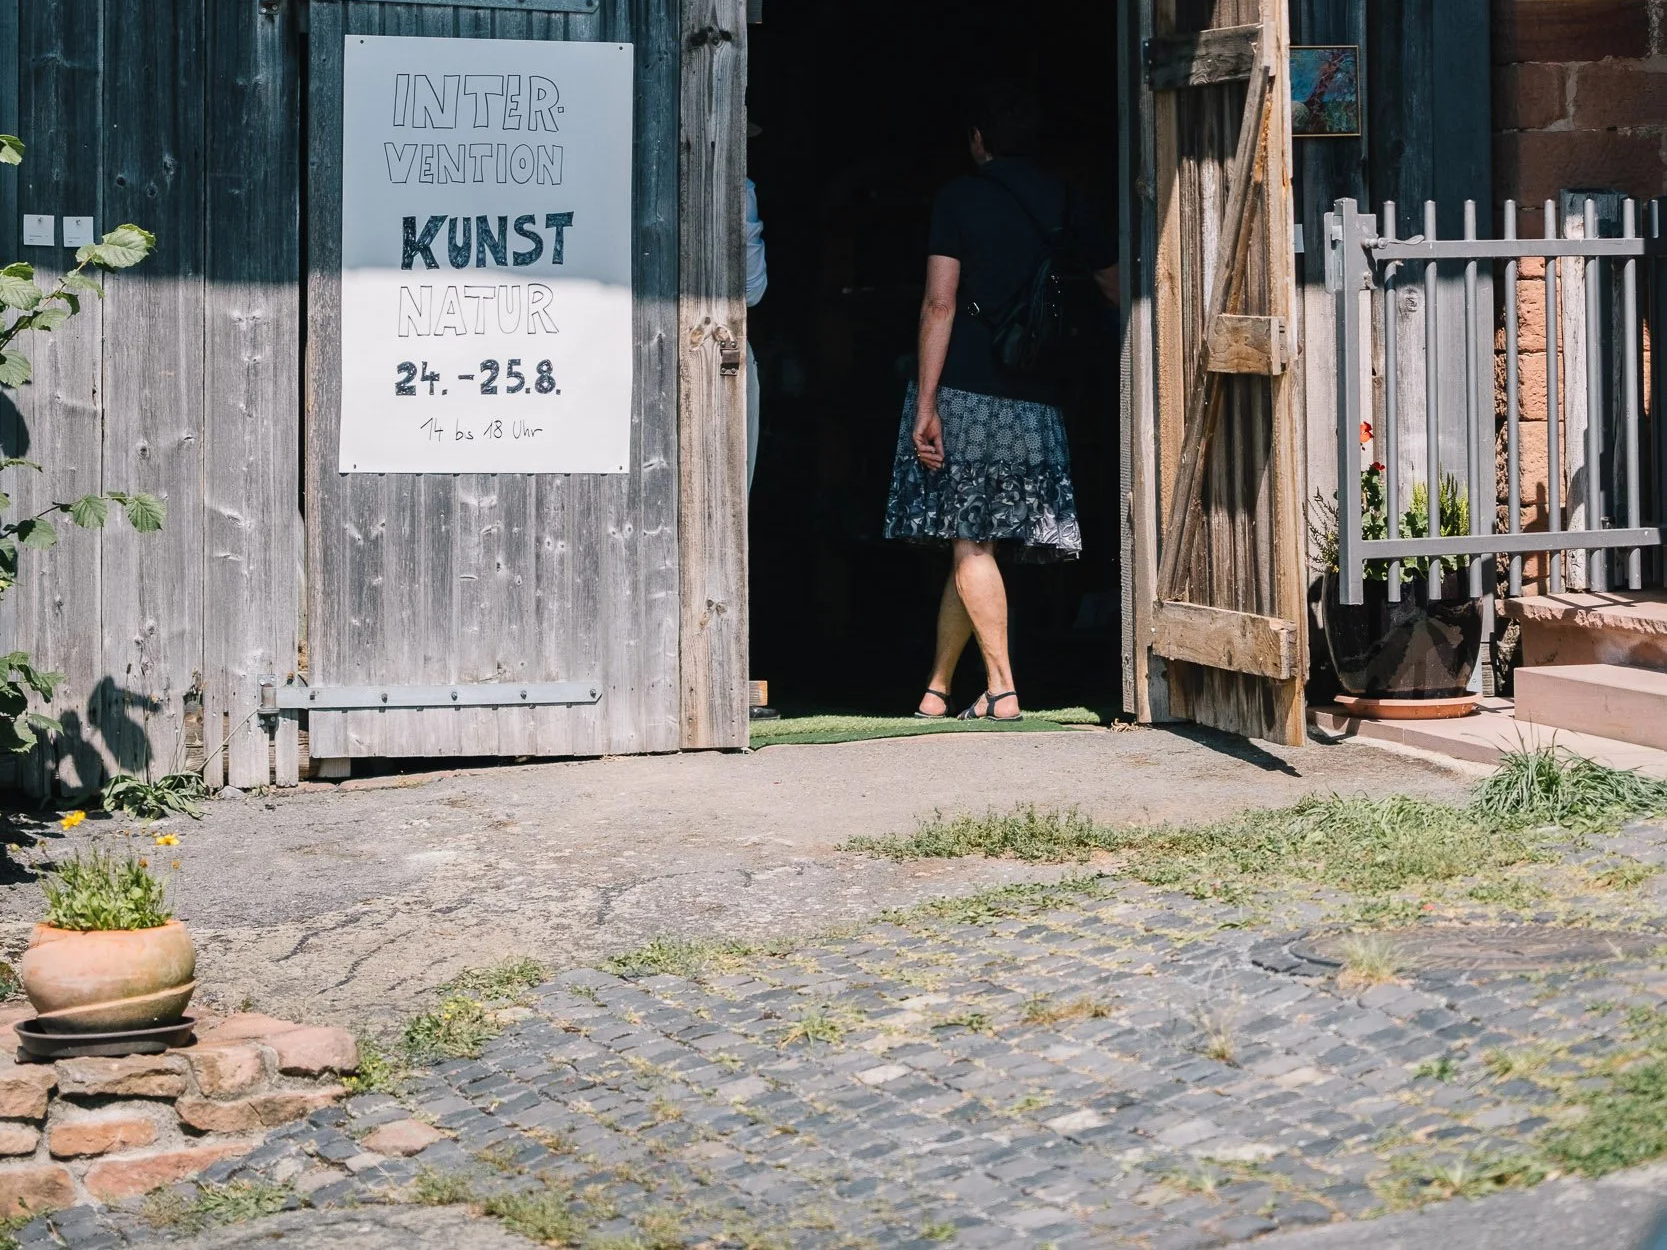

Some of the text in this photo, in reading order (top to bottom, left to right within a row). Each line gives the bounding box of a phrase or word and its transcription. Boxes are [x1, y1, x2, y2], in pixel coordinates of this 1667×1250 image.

[384, 142, 564, 186] VENTION
[400, 211, 575, 271] KUNST
[397, 283, 560, 338] NATUR
[419, 417, 445, 443] 14
[483, 419, 504, 440] 18
[512, 419, 544, 441] Uhr
